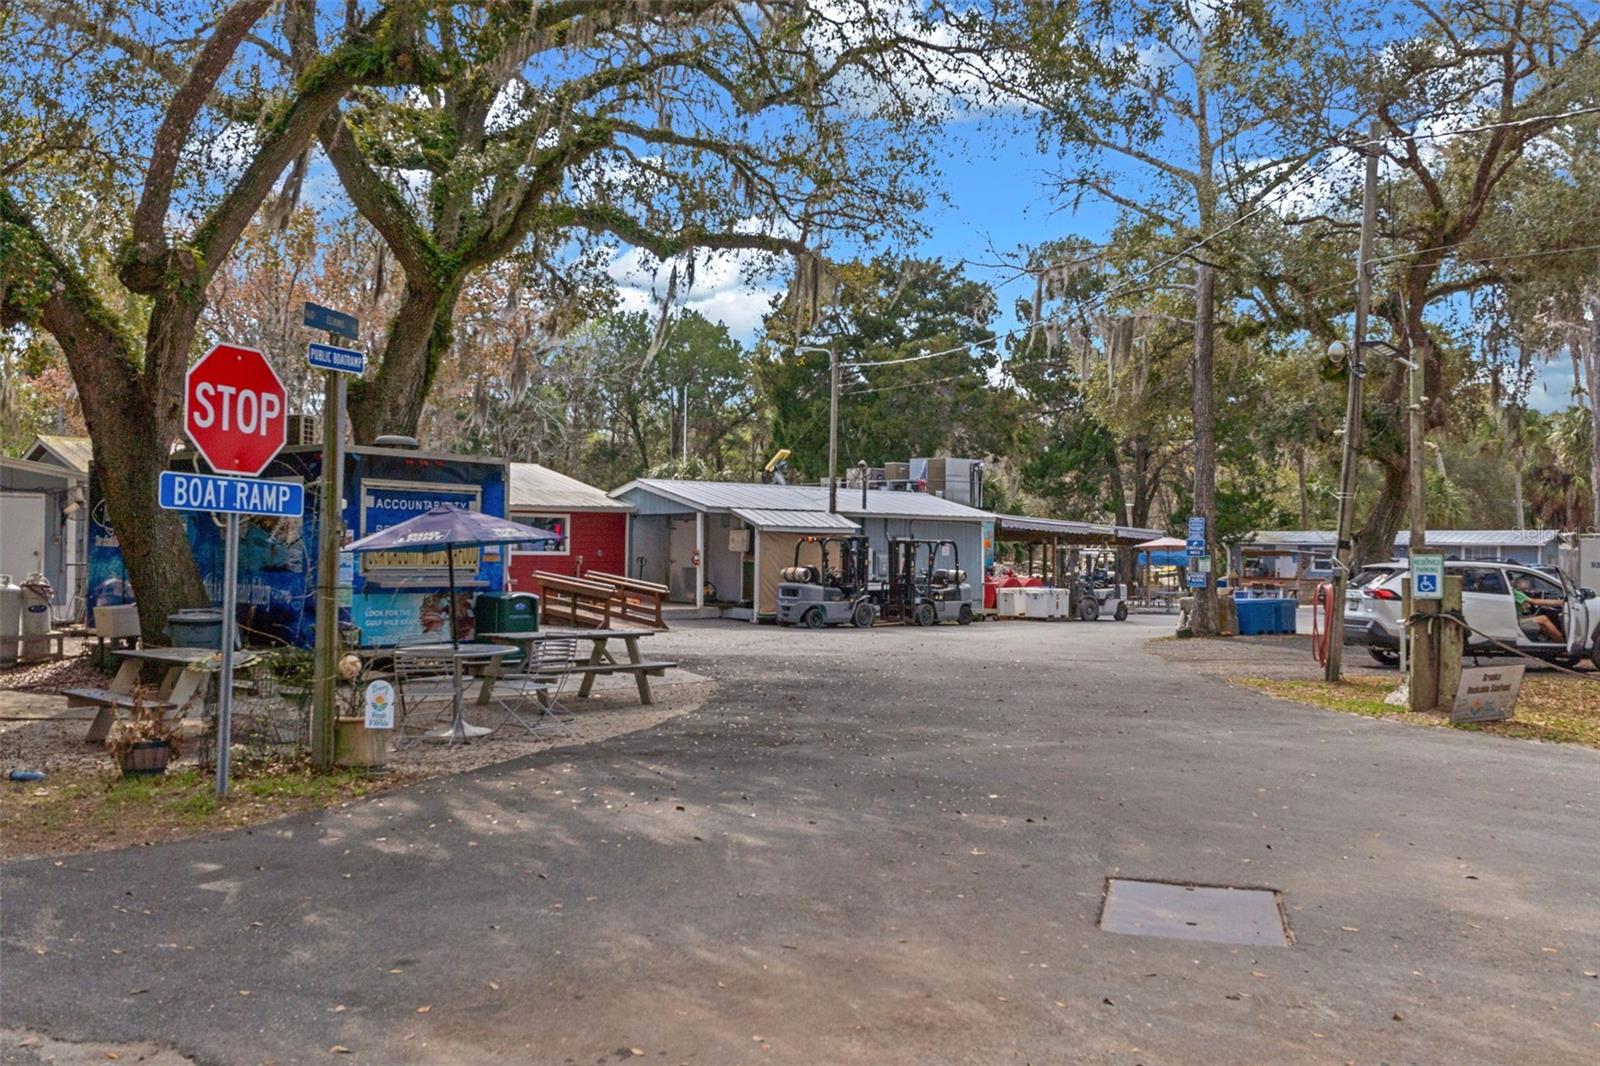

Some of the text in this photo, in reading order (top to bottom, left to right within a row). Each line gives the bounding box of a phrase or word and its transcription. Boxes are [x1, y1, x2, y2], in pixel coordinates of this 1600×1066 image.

[310, 347, 332, 363] PUBLIC
[193, 381, 281, 436] STOP
[174, 476, 290, 512] BOAT RAMP
